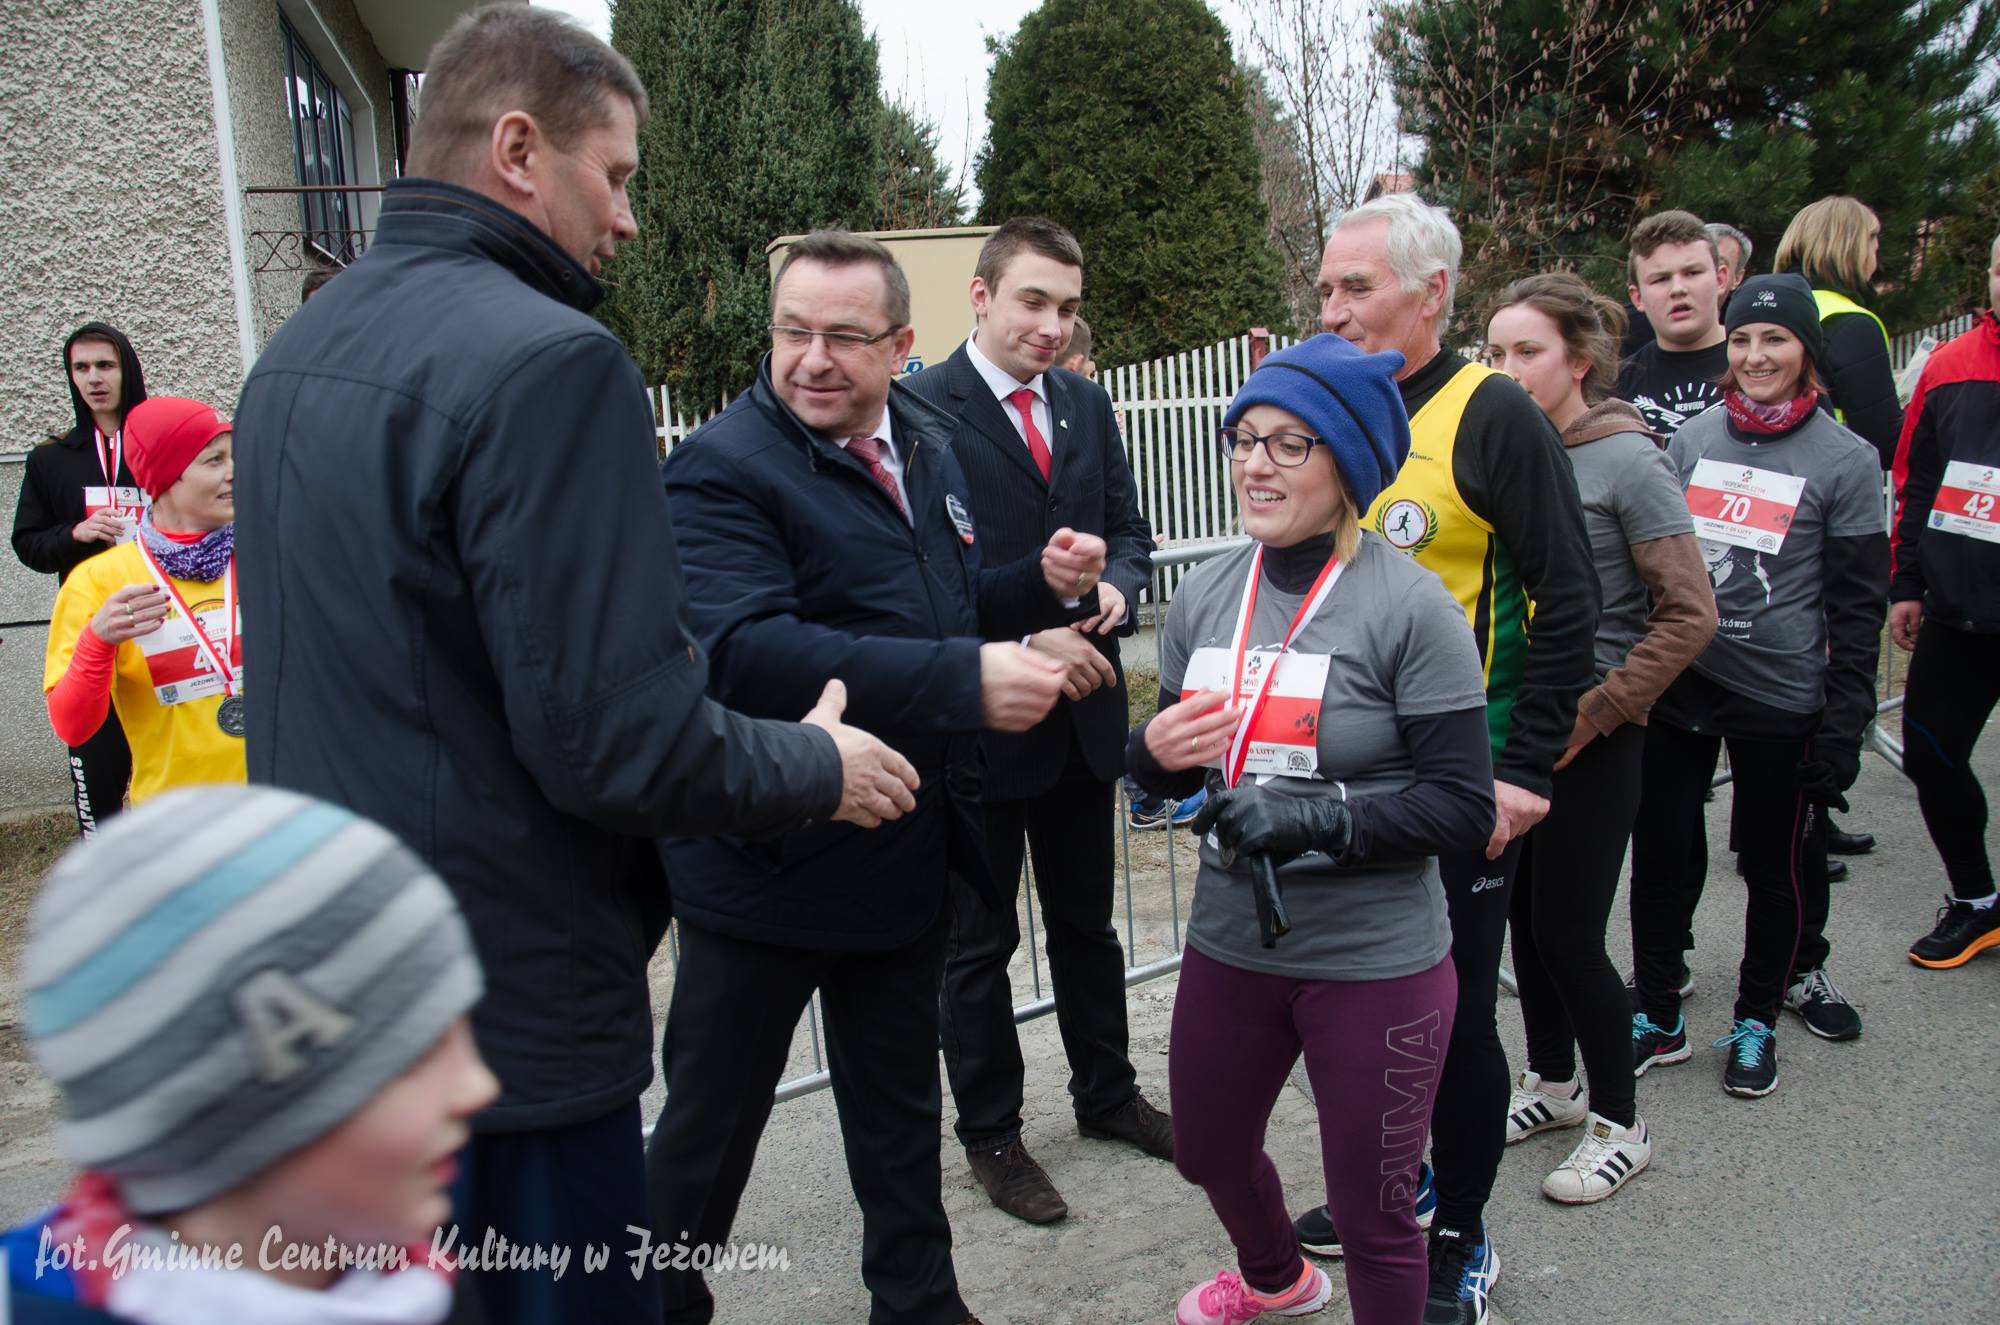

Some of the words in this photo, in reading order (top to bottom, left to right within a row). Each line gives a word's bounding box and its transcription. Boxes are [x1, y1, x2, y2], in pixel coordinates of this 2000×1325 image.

[1674, 400, 1706, 412] NERVOUS
[1718, 493, 1752, 523] 70
[1963, 493, 1996, 520] 42
[1256, 748, 1275, 756] LUTY
[1485, 876, 1505, 889] asics
[231, 966, 358, 1083] A
[1380, 1009, 1440, 1212] PUMA
